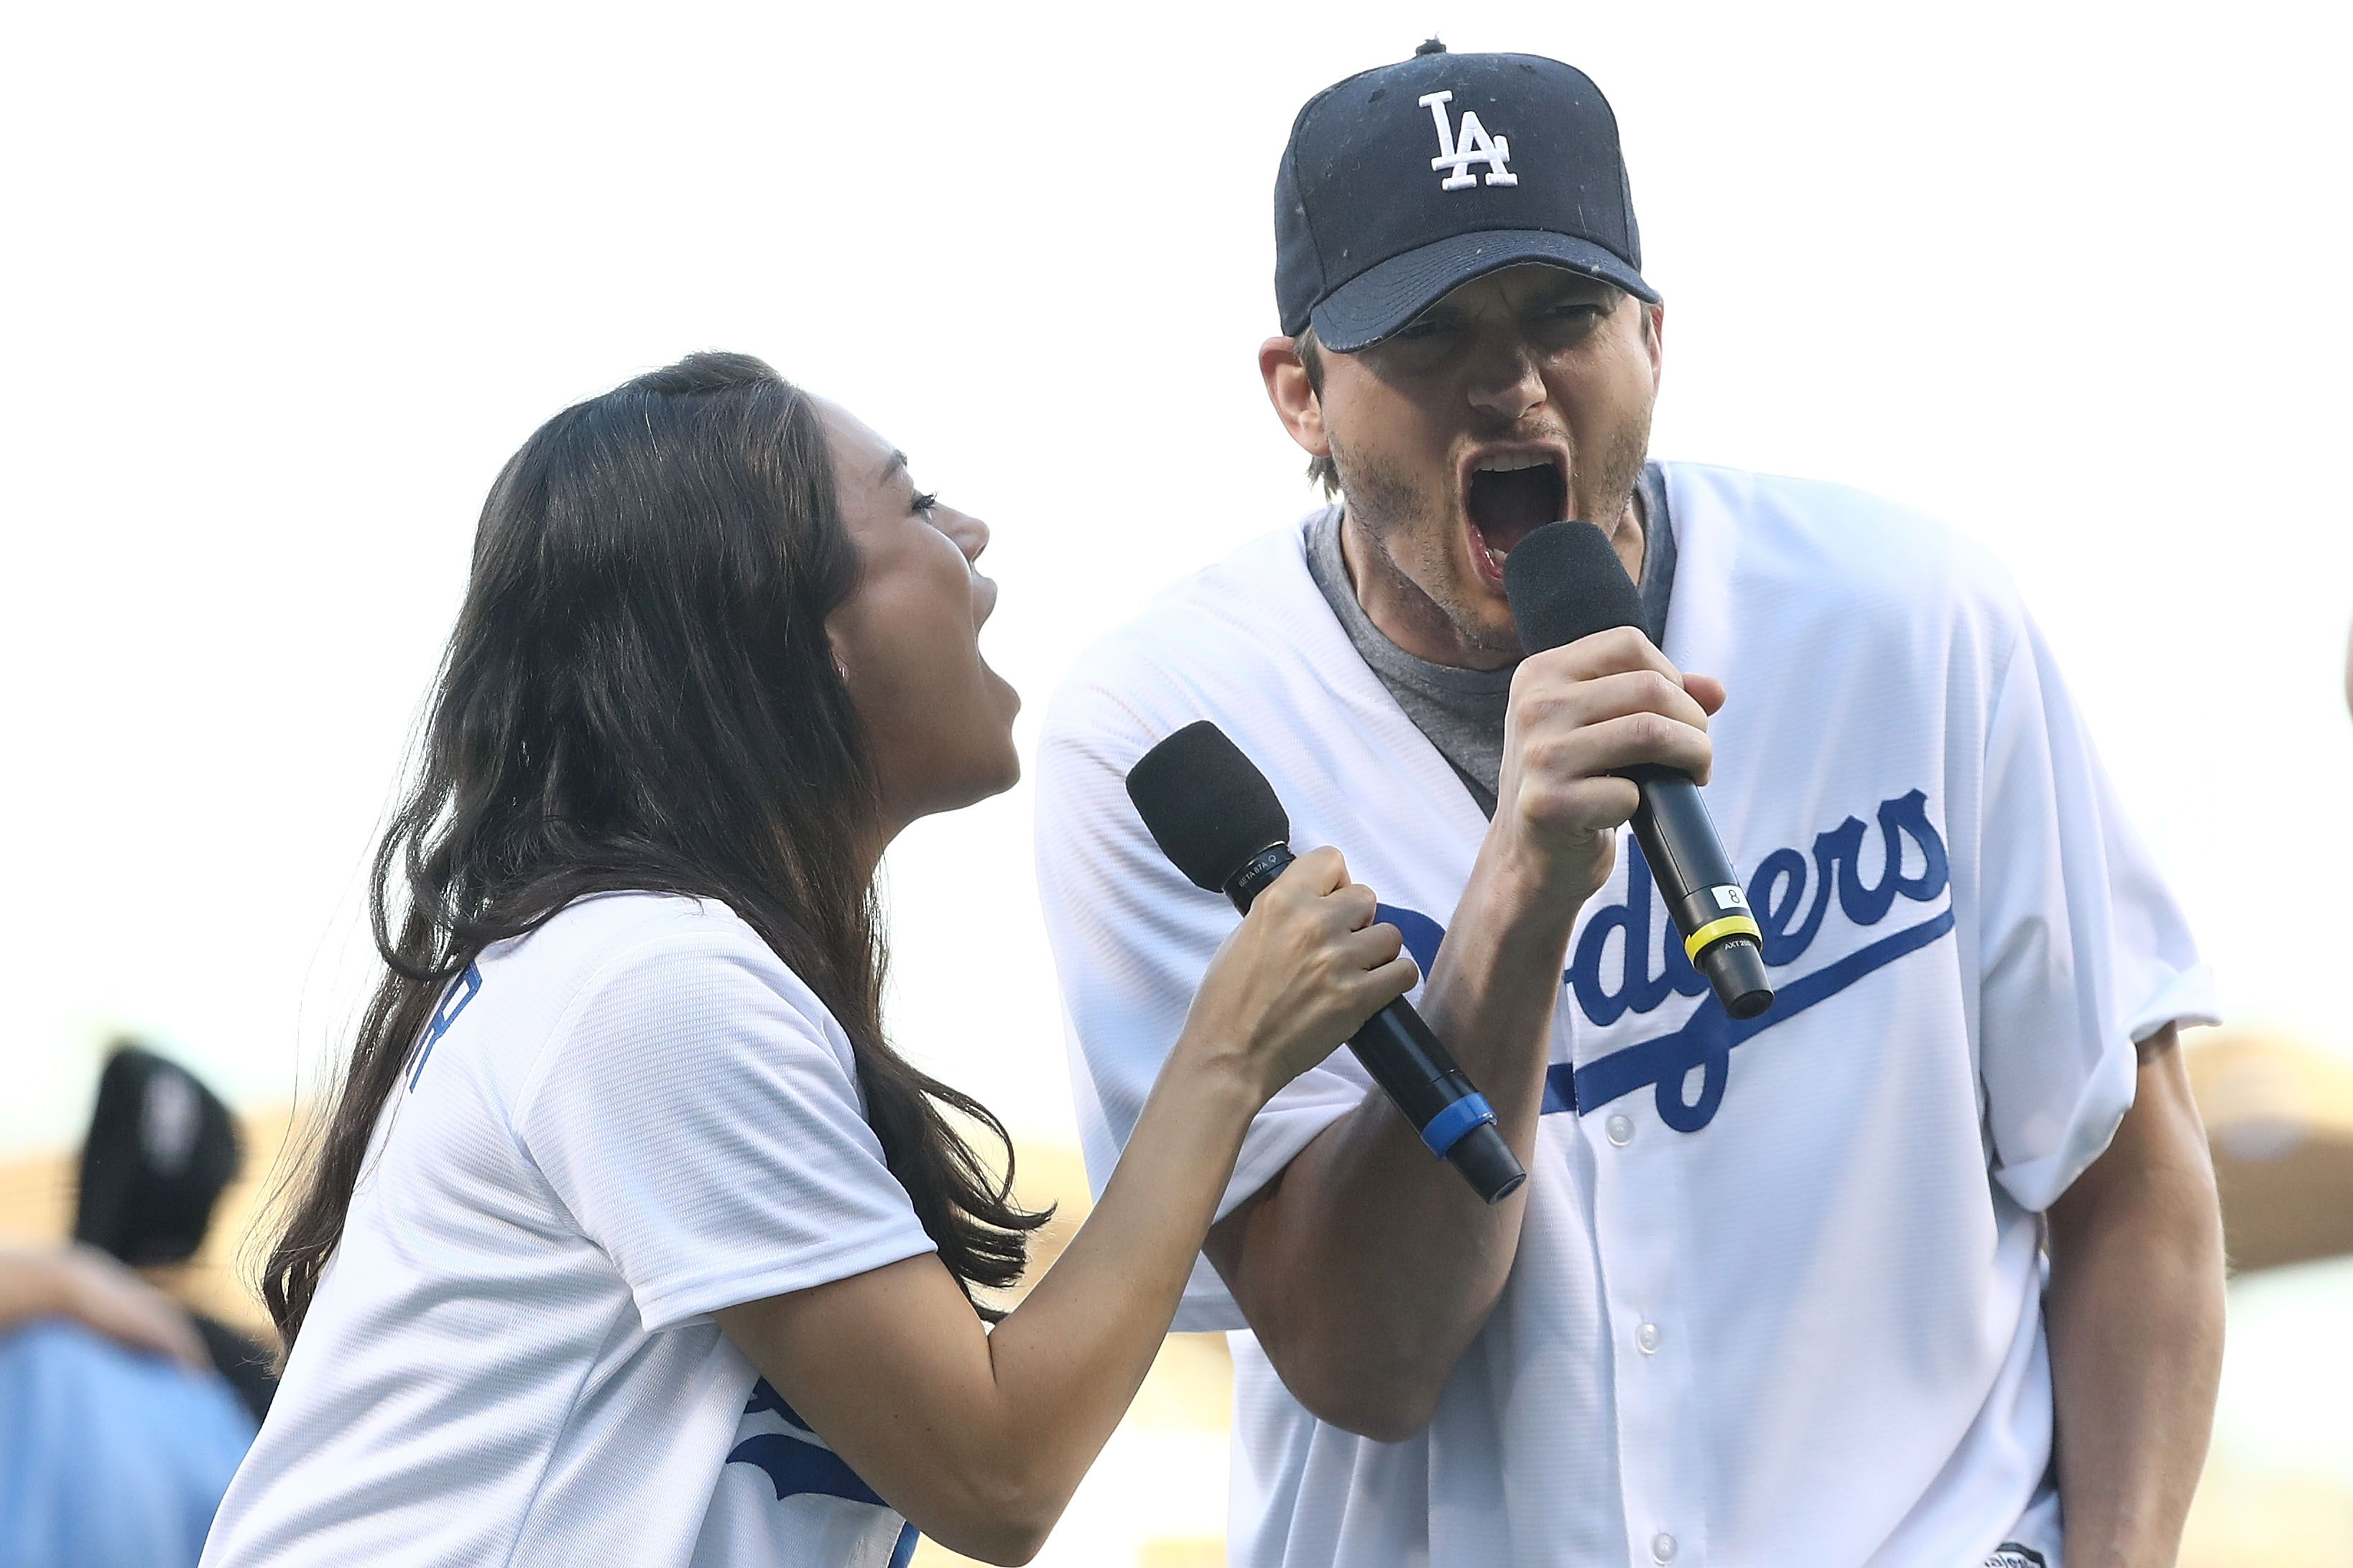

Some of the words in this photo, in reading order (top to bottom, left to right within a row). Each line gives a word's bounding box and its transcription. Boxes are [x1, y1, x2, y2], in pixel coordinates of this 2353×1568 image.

[1418, 90, 1518, 191] LA
[1238, 871, 1255, 888] BETA
[1729, 889, 1740, 903] 8
